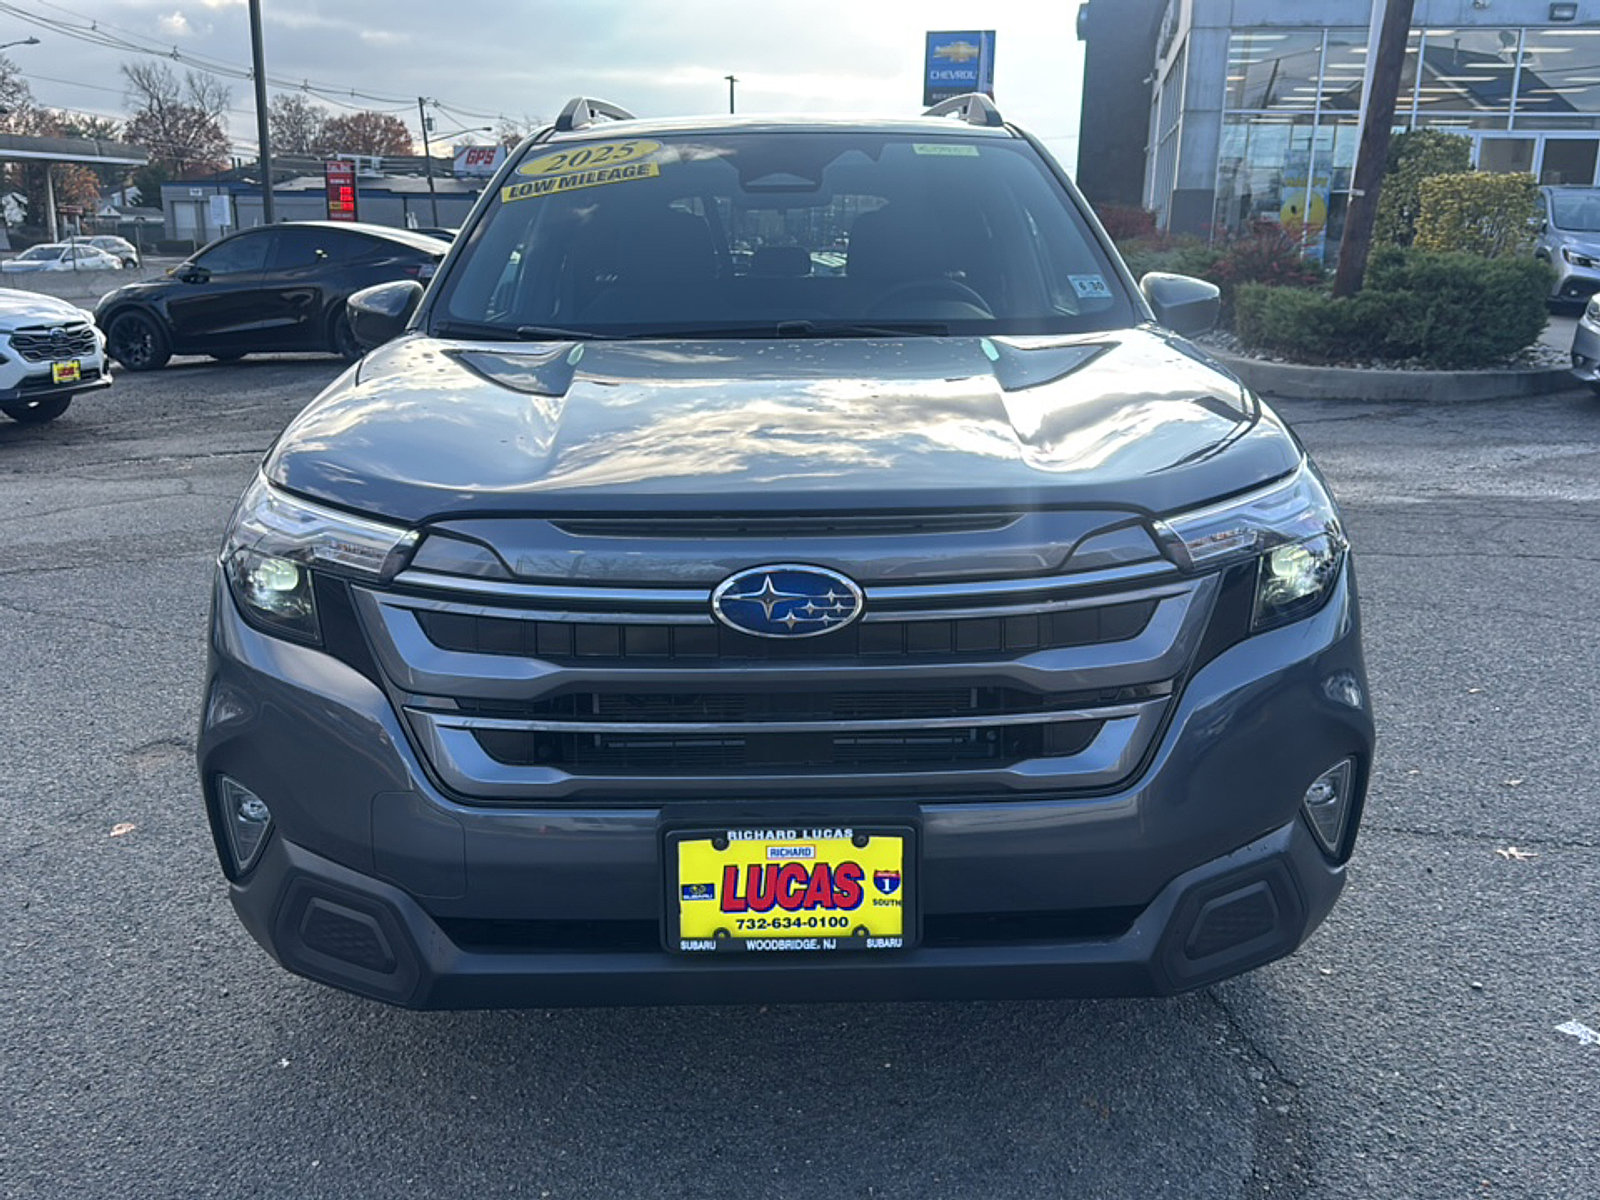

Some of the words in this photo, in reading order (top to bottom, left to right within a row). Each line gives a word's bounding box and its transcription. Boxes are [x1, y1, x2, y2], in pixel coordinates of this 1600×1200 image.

[466, 150, 496, 165] GPS
[543, 141, 638, 173] 2025
[508, 179, 555, 199] LOW
[558, 163, 650, 190] MILEAGE
[727, 830, 797, 840] RICHARD
[803, 828, 854, 839] LUCAS
[769, 848, 812, 857] RICHARD
[720, 861, 866, 914] LUCAS
[872, 898, 903, 907] SOUTH
[735, 916, 849, 930] 732-634-0100
[680, 940, 717, 951] SUBARU
[823, 938, 837, 950] NJ
[866, 938, 903, 948] SUBARU
